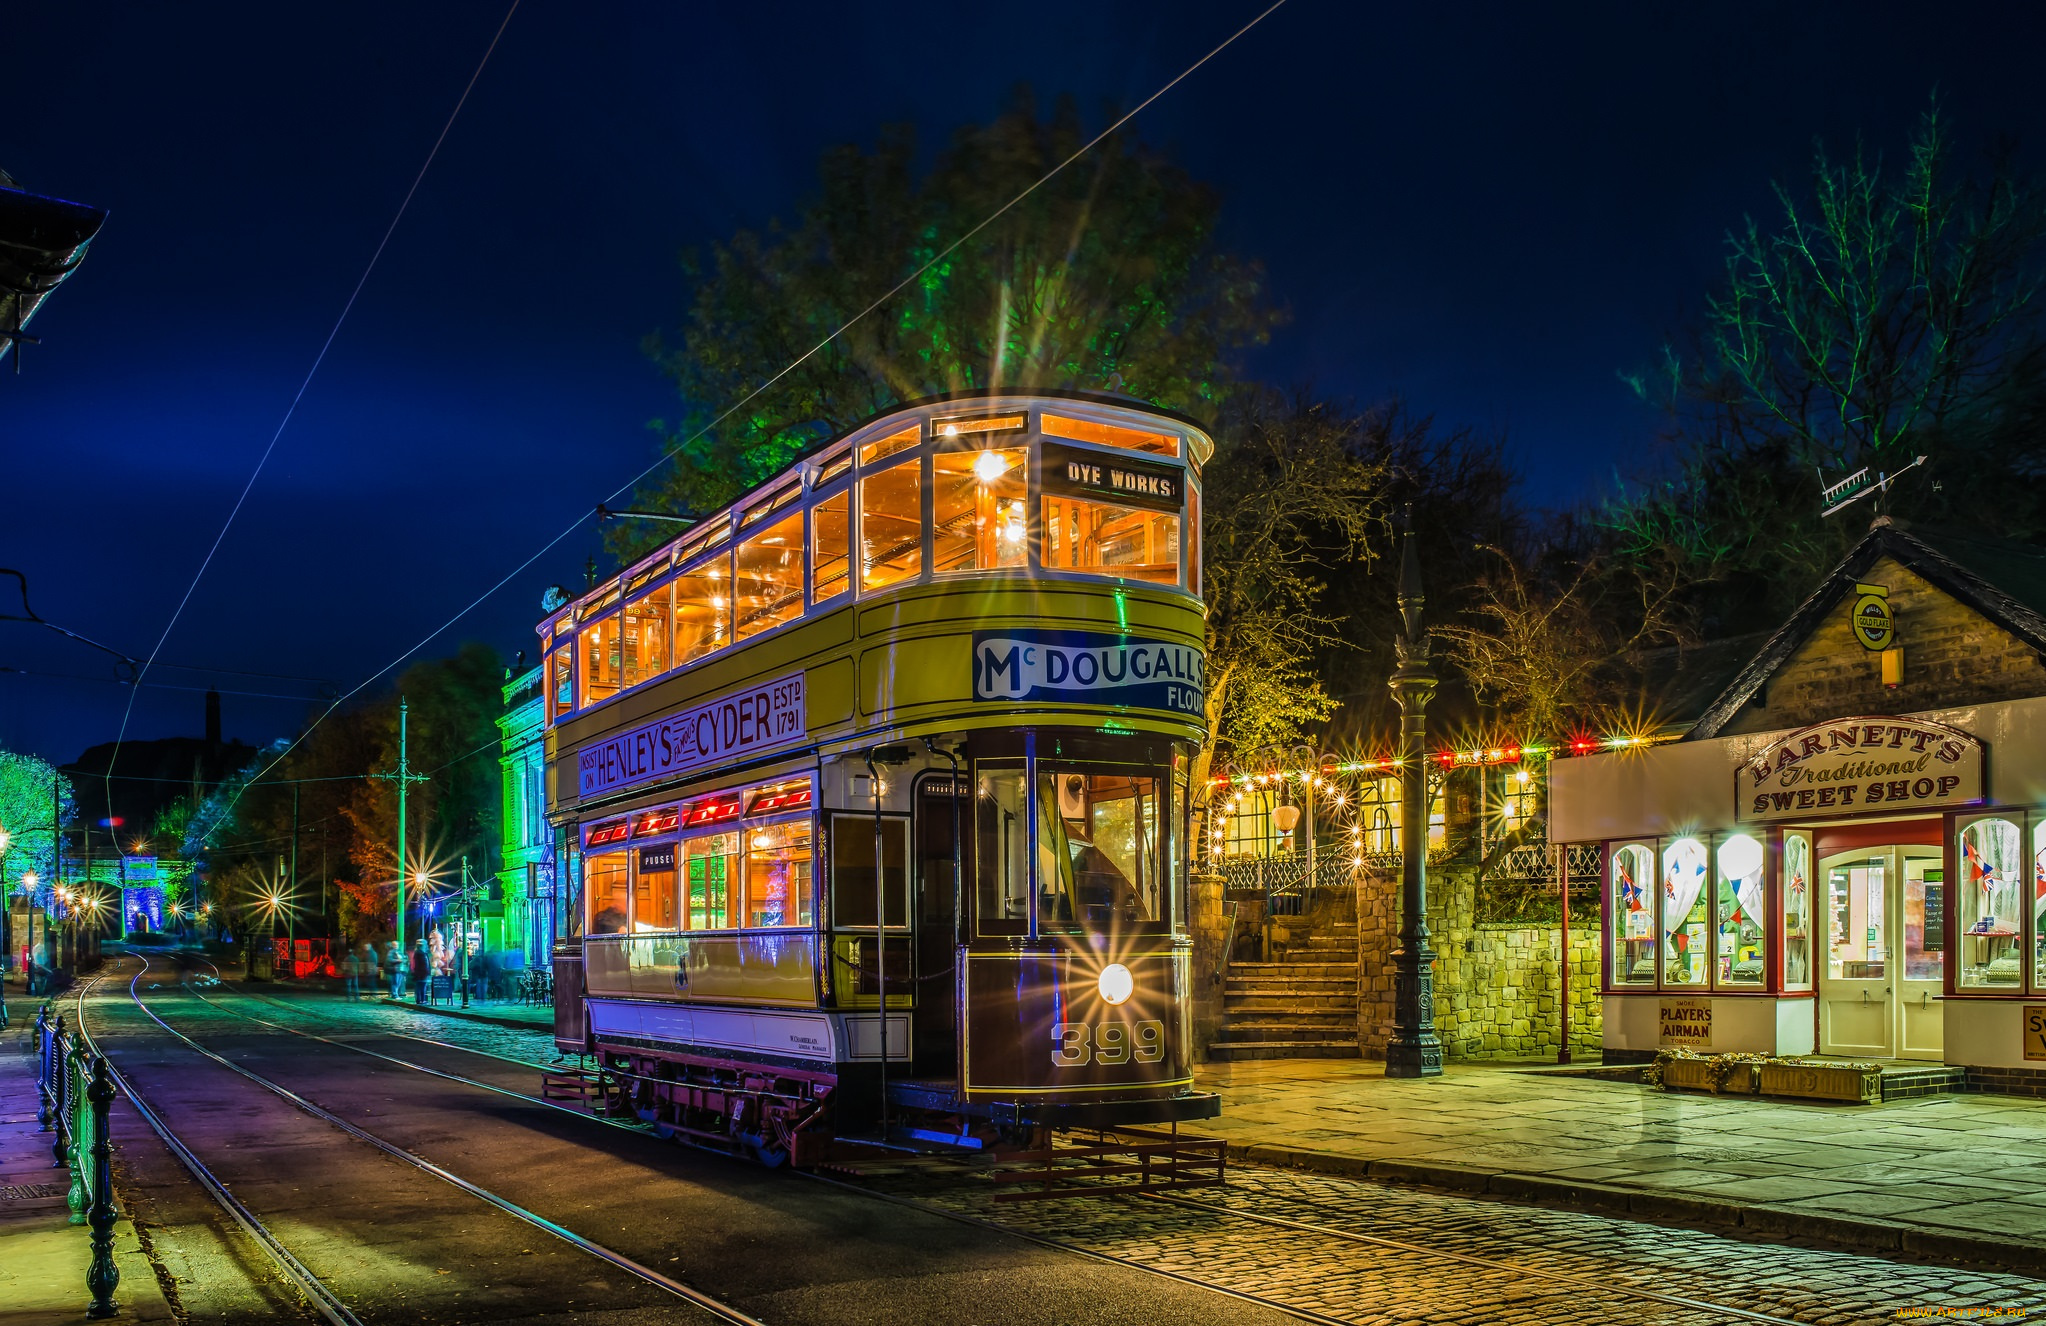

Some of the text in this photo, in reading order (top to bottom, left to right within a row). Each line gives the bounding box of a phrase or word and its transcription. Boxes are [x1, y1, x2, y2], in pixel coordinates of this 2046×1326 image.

[1068, 462, 1171, 497] DYE WORKS
[1859, 617, 1889, 628] GOLD FLAKE
[598, 691, 772, 786] HENLEY'S FAMOUS CYDER
[776, 708, 799, 736] 1791
[580, 750, 597, 771] INSIST
[1750, 725, 1966, 788] BARNETT'S
[1780, 752, 1933, 787] Traditional
[585, 772, 594, 790] ON
[1753, 775, 1961, 814] SWEET SHOP
[1661, 1007, 1712, 1022] PLAYER'S
[1051, 1019, 1165, 1067] 399
